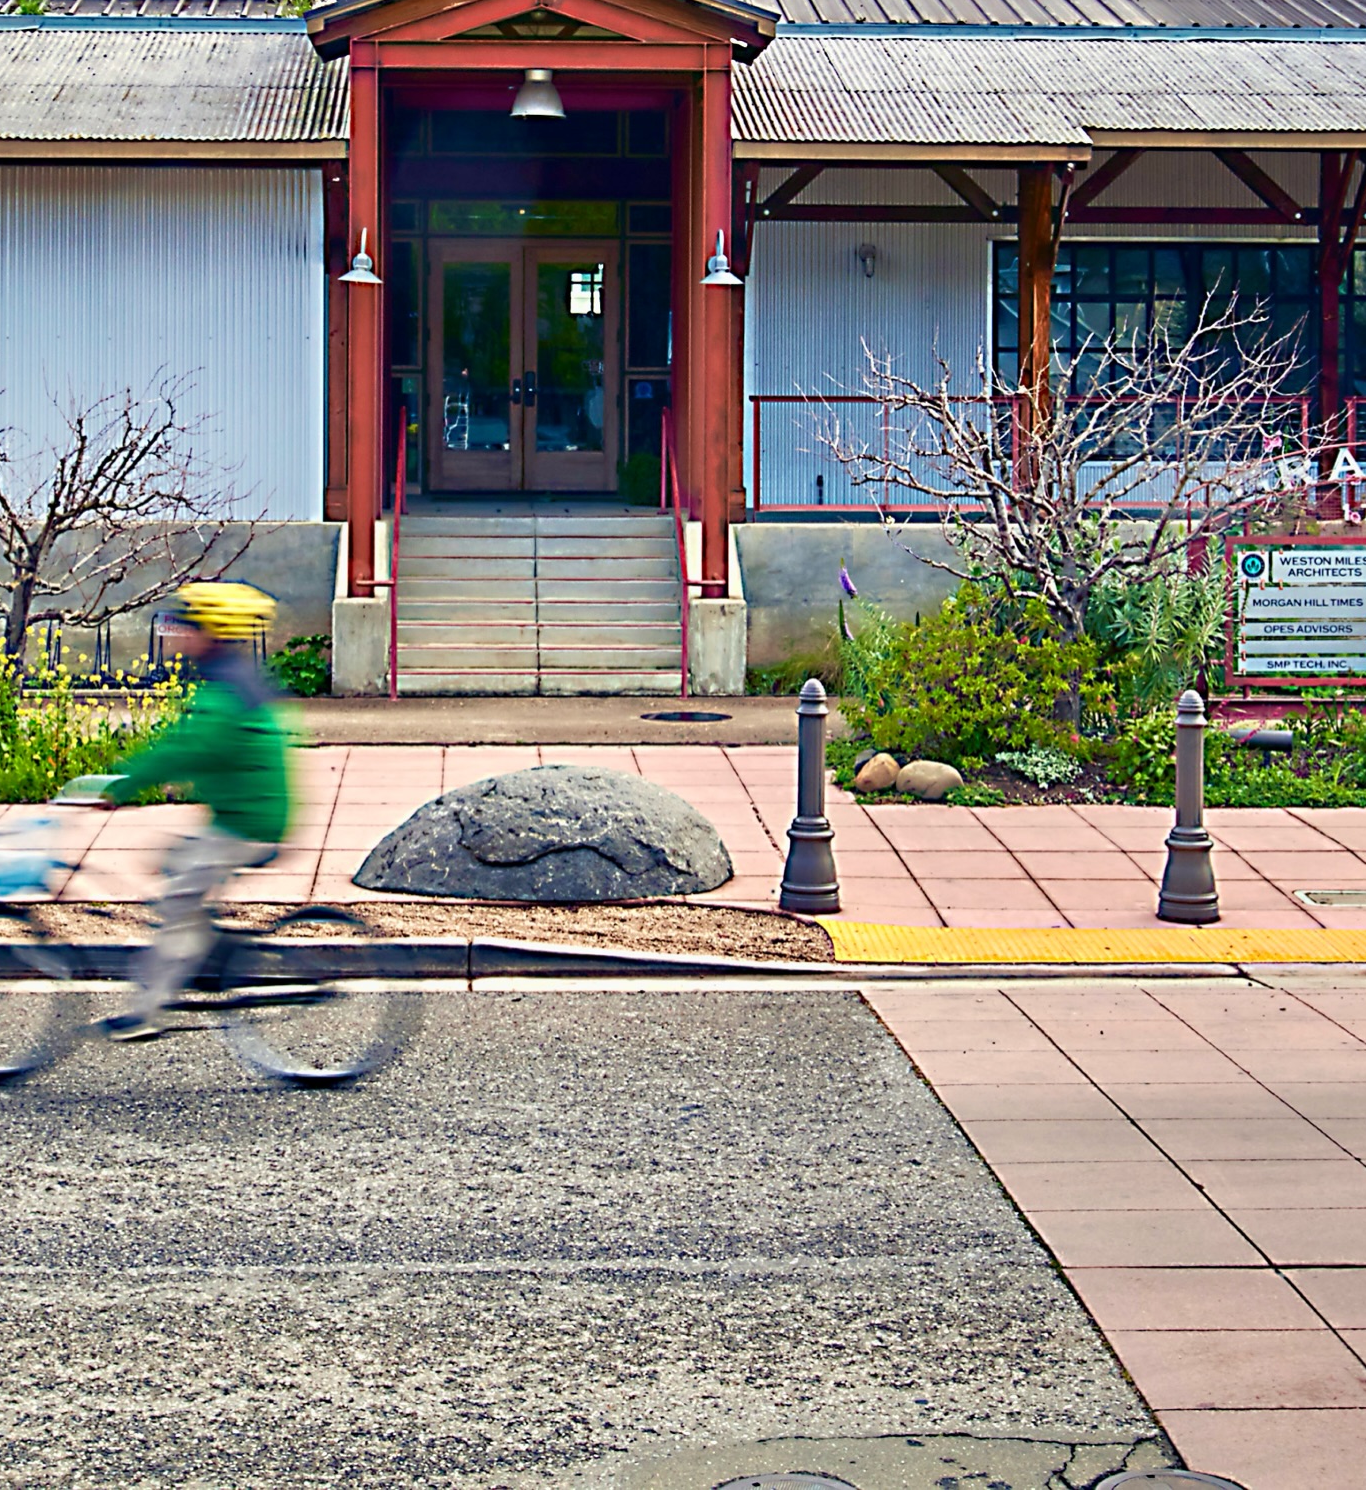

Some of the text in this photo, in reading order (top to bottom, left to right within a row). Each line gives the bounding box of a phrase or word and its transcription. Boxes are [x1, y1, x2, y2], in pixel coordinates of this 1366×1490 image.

[1279, 556, 1332, 566] WESTON
[1287, 568, 1363, 577] ARCHITECTS
[1252, 598, 1364, 607] MORGAN HILL TIMES
[1263, 625, 1353, 634] OPES ADVISORS
[1267, 661, 1291, 669] SMP
